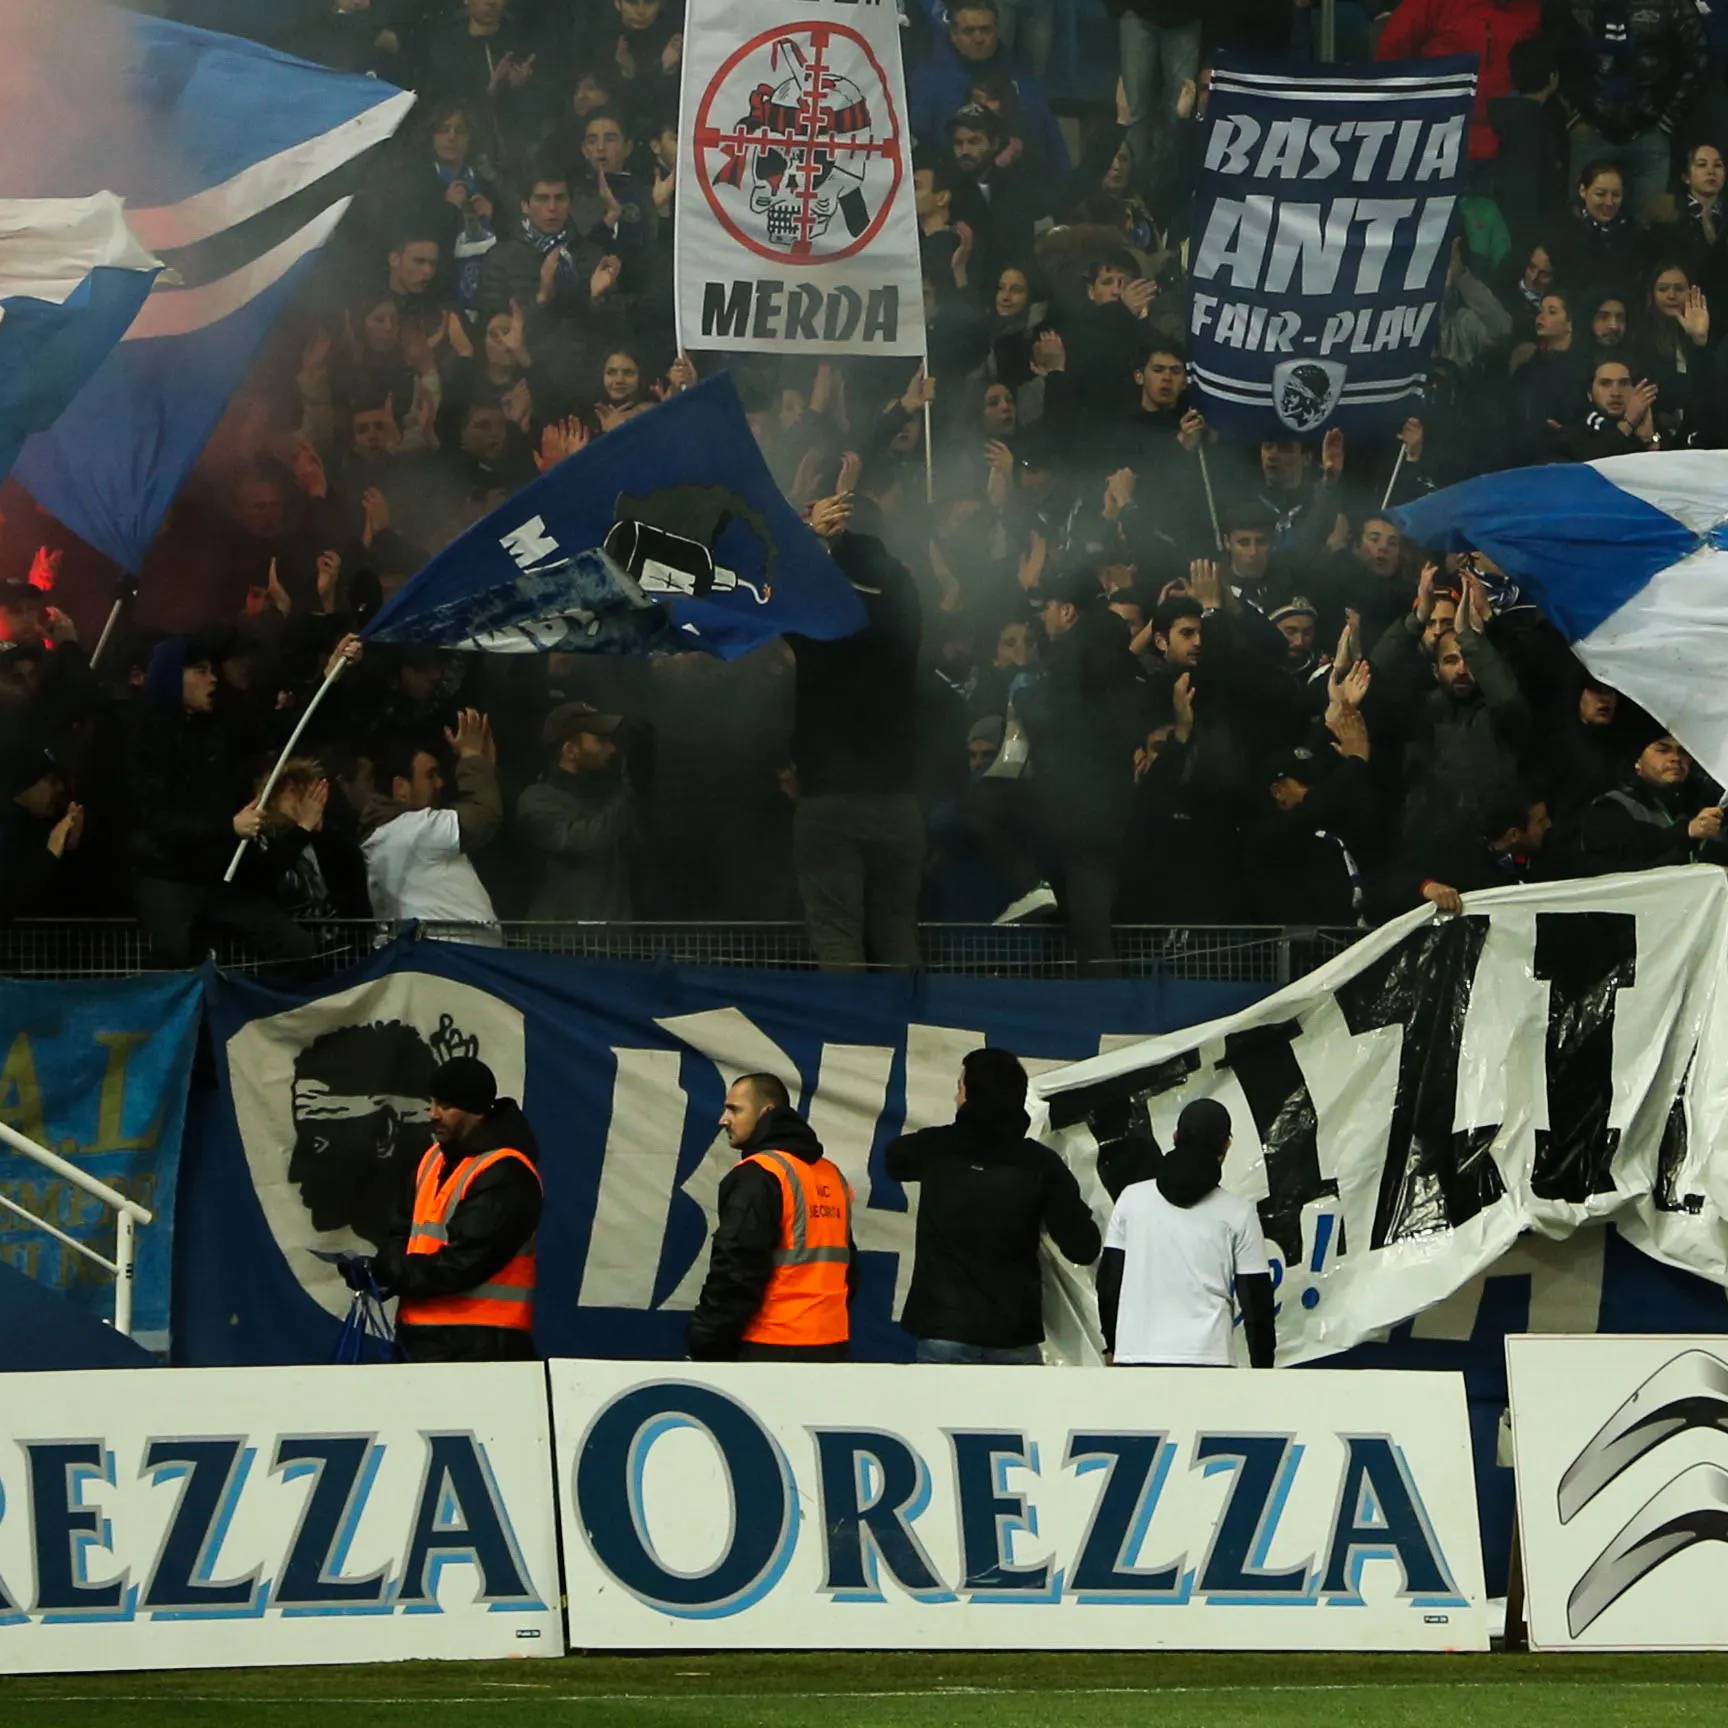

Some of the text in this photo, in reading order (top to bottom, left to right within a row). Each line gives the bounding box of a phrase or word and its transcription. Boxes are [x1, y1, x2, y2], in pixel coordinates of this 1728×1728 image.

[1204, 114, 1466, 182] BASTIA
[1193, 194, 1457, 296] ANTI
[701, 280, 900, 343] MERDA
[1191, 292, 1437, 356] FAIR-PLAY
[573, 1377, 1472, 1620] OREZZA
